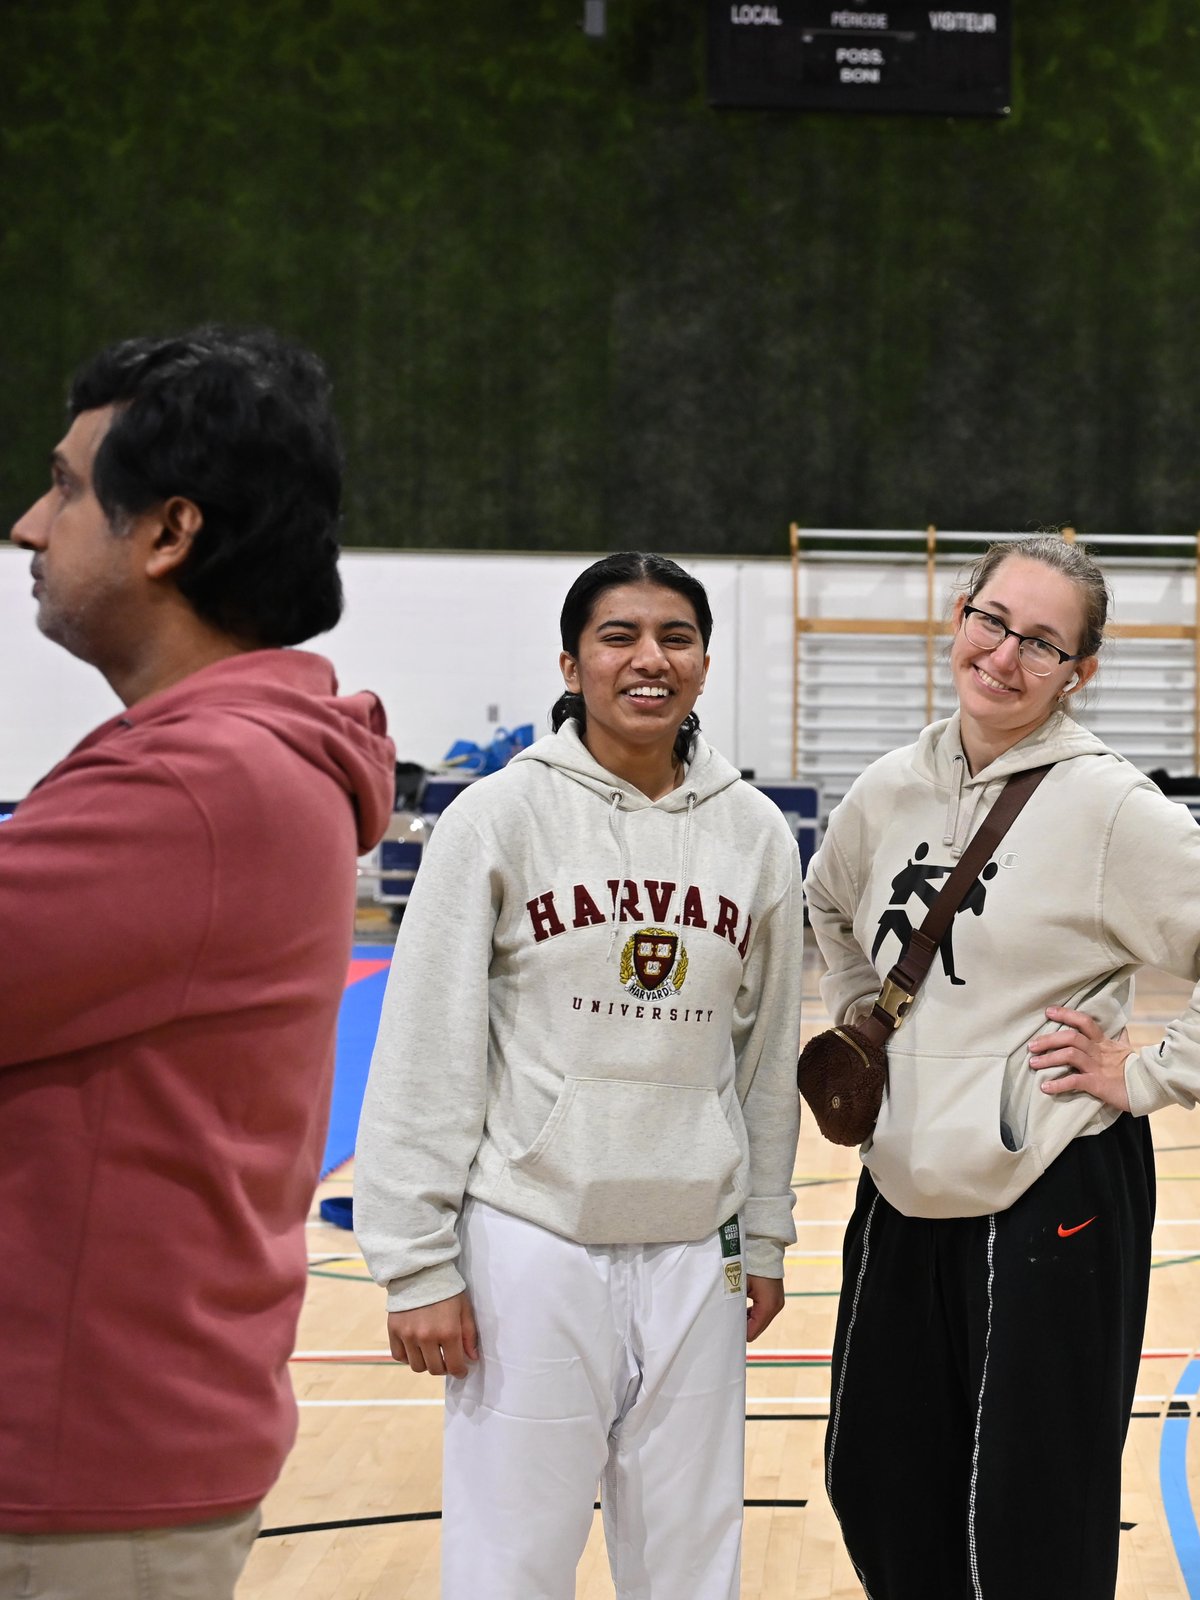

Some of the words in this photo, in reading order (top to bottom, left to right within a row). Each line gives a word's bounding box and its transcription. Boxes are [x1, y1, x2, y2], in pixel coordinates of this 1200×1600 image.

[731, 5, 782, 25] LOCAL
[629, 984, 669, 1001] HARVARD
[572, 997, 713, 1022] UNIVERSITY
